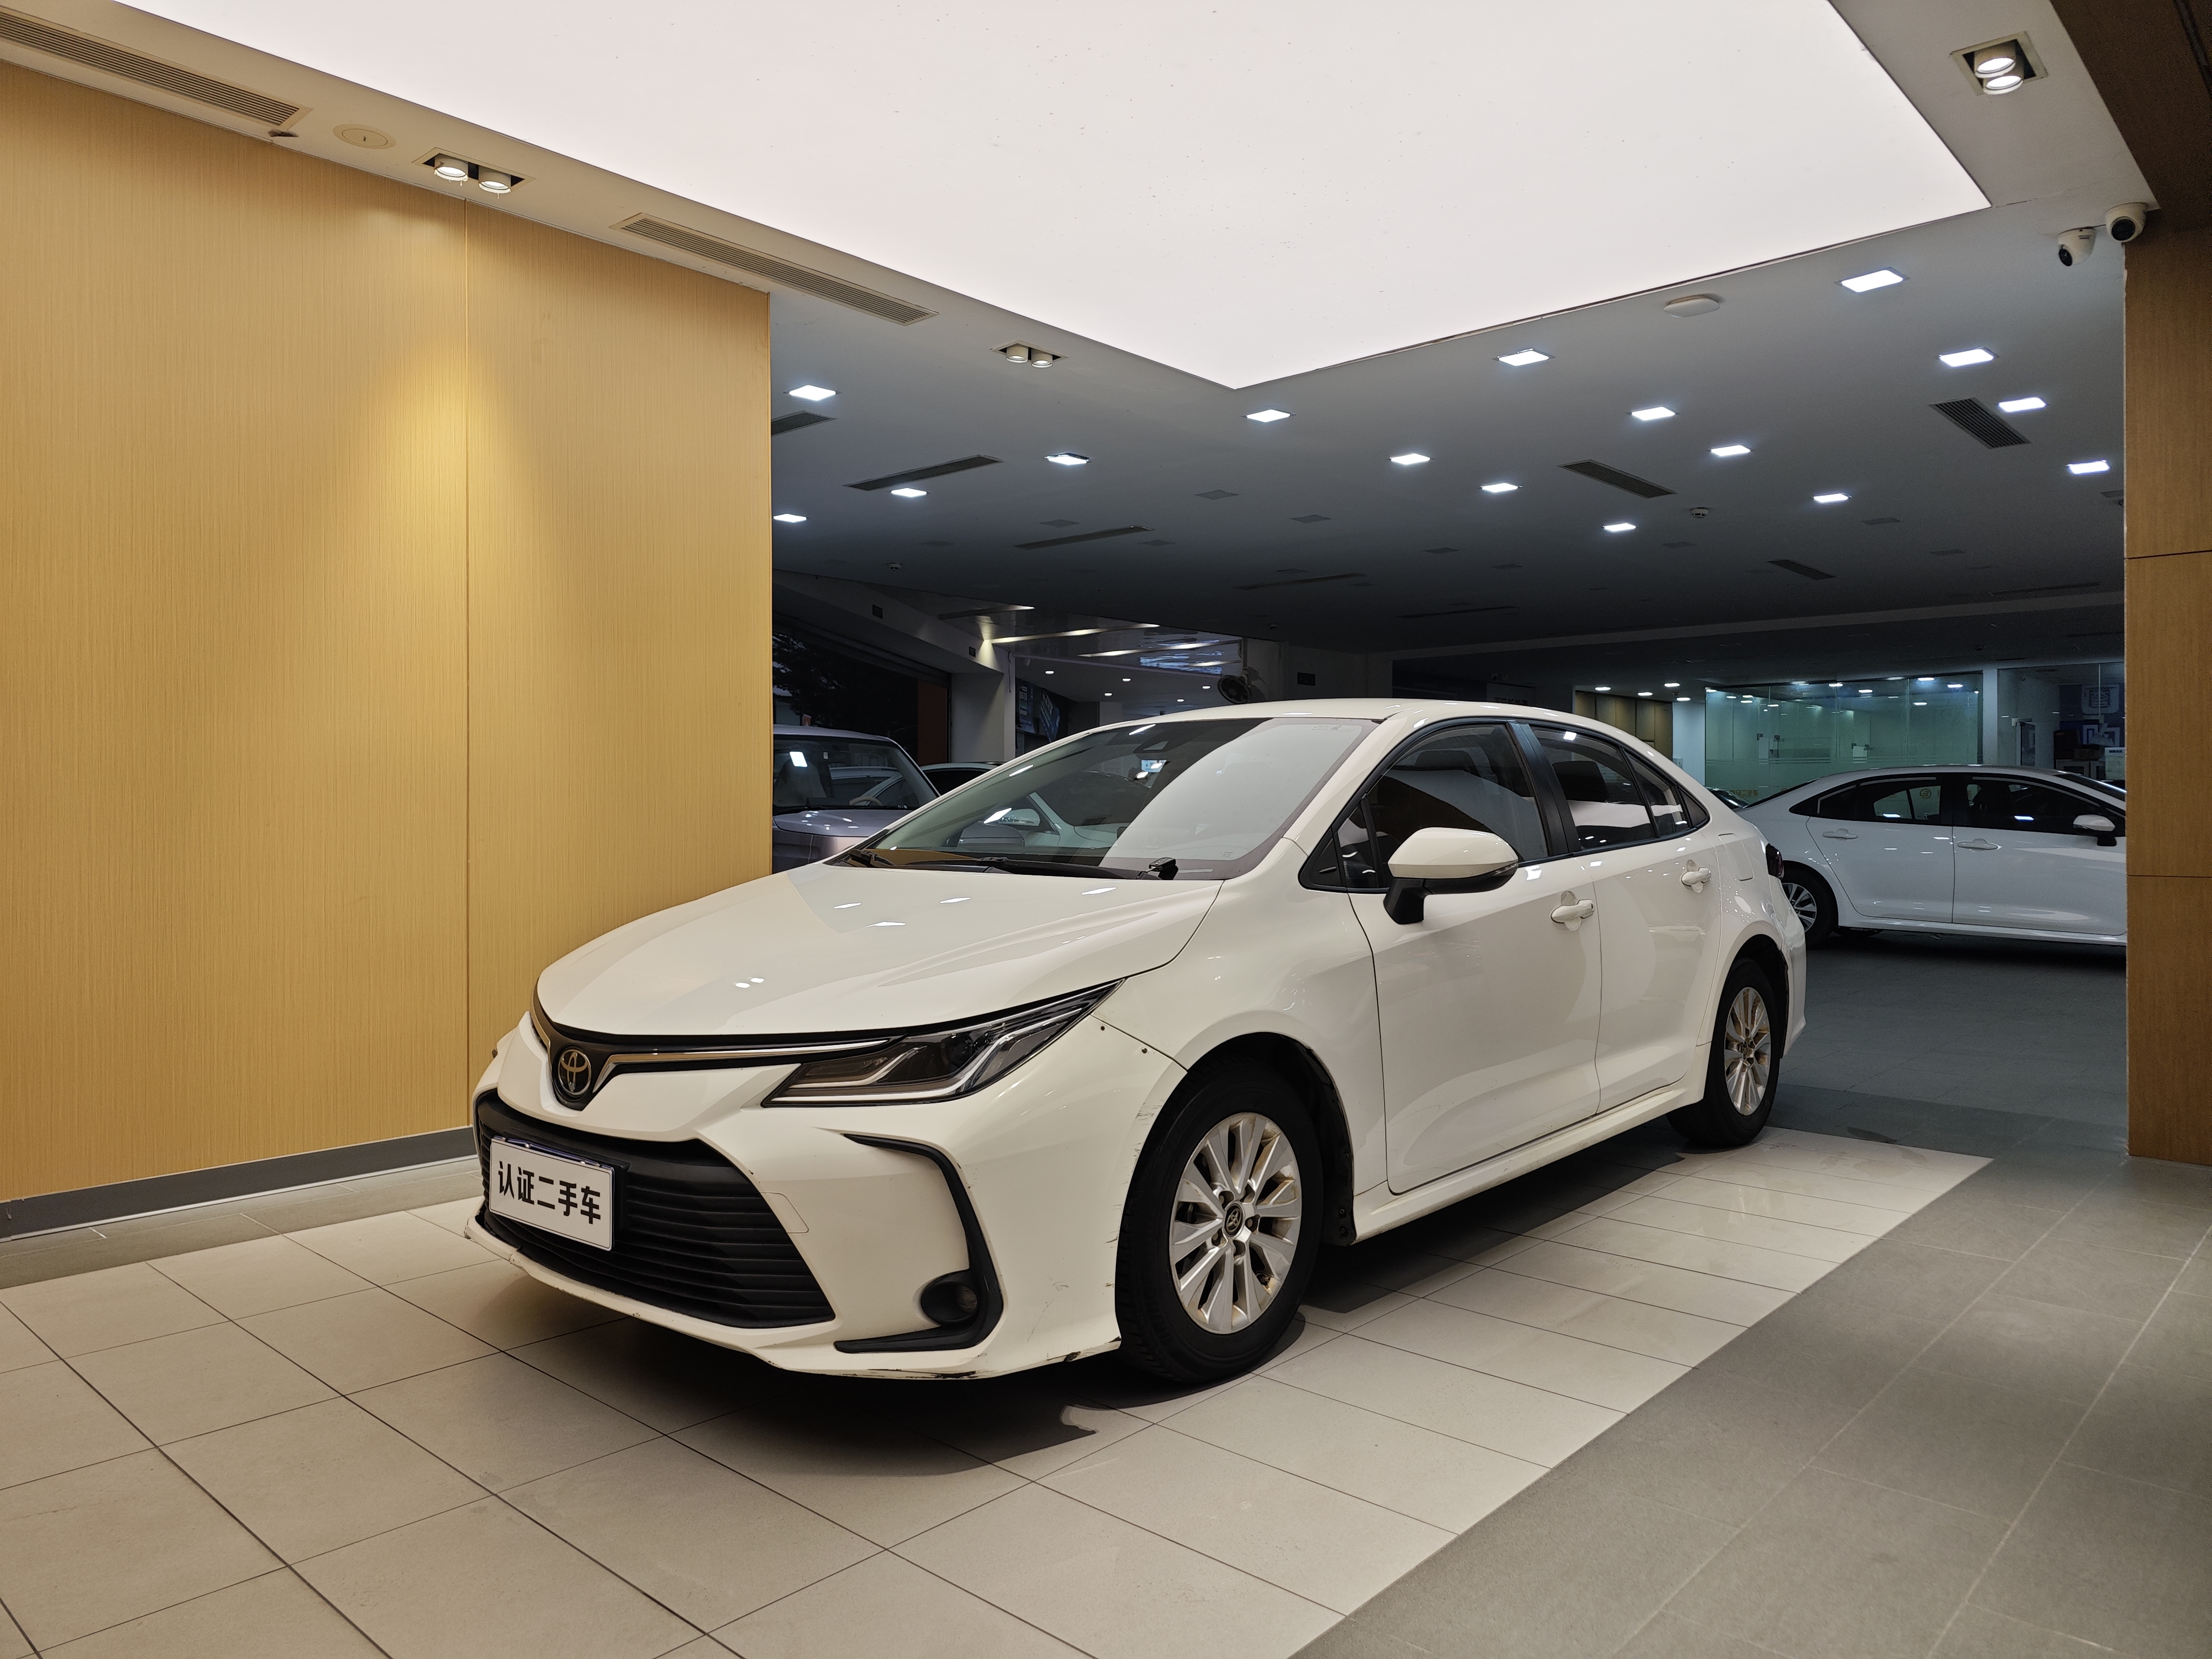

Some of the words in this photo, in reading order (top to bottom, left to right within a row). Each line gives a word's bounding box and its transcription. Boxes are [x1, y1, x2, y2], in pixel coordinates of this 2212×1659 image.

[498, 1161, 601, 1224] 认证二手车
